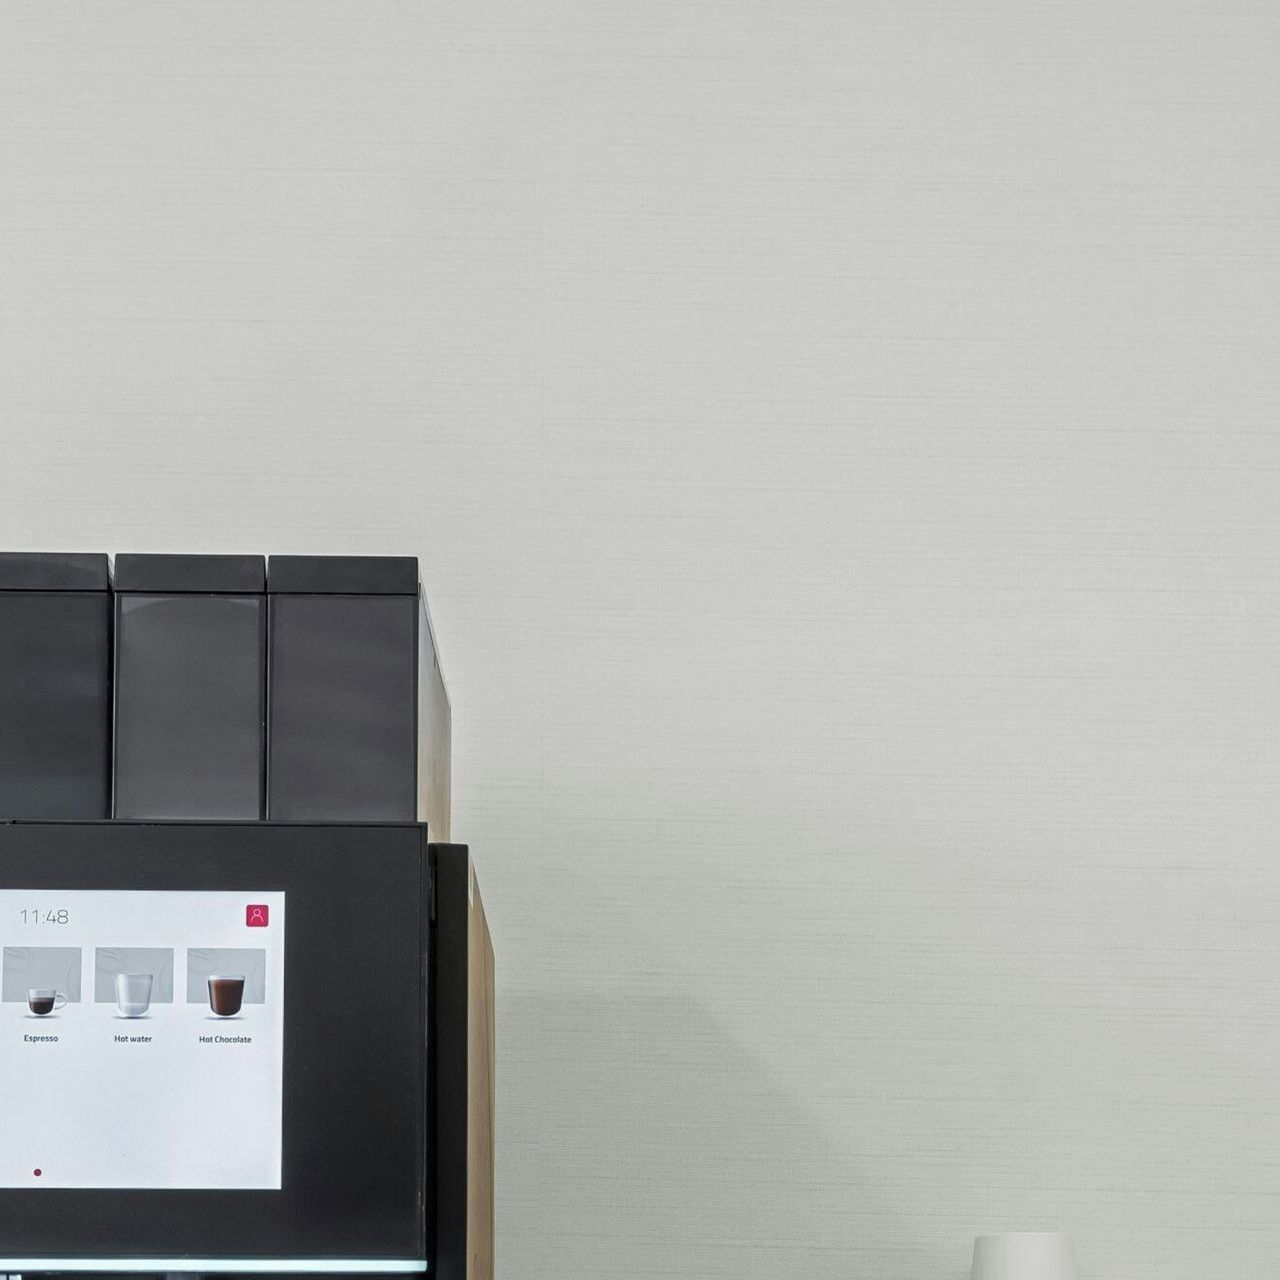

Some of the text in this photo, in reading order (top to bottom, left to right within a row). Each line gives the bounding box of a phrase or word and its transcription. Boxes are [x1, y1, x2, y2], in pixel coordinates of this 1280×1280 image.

[20, 909, 69, 925] 11:48
[23, 1034, 59, 1043] Espresso
[114, 1035, 152, 1043] Hot water
[198, 1035, 252, 1044] Hot Chocolate
